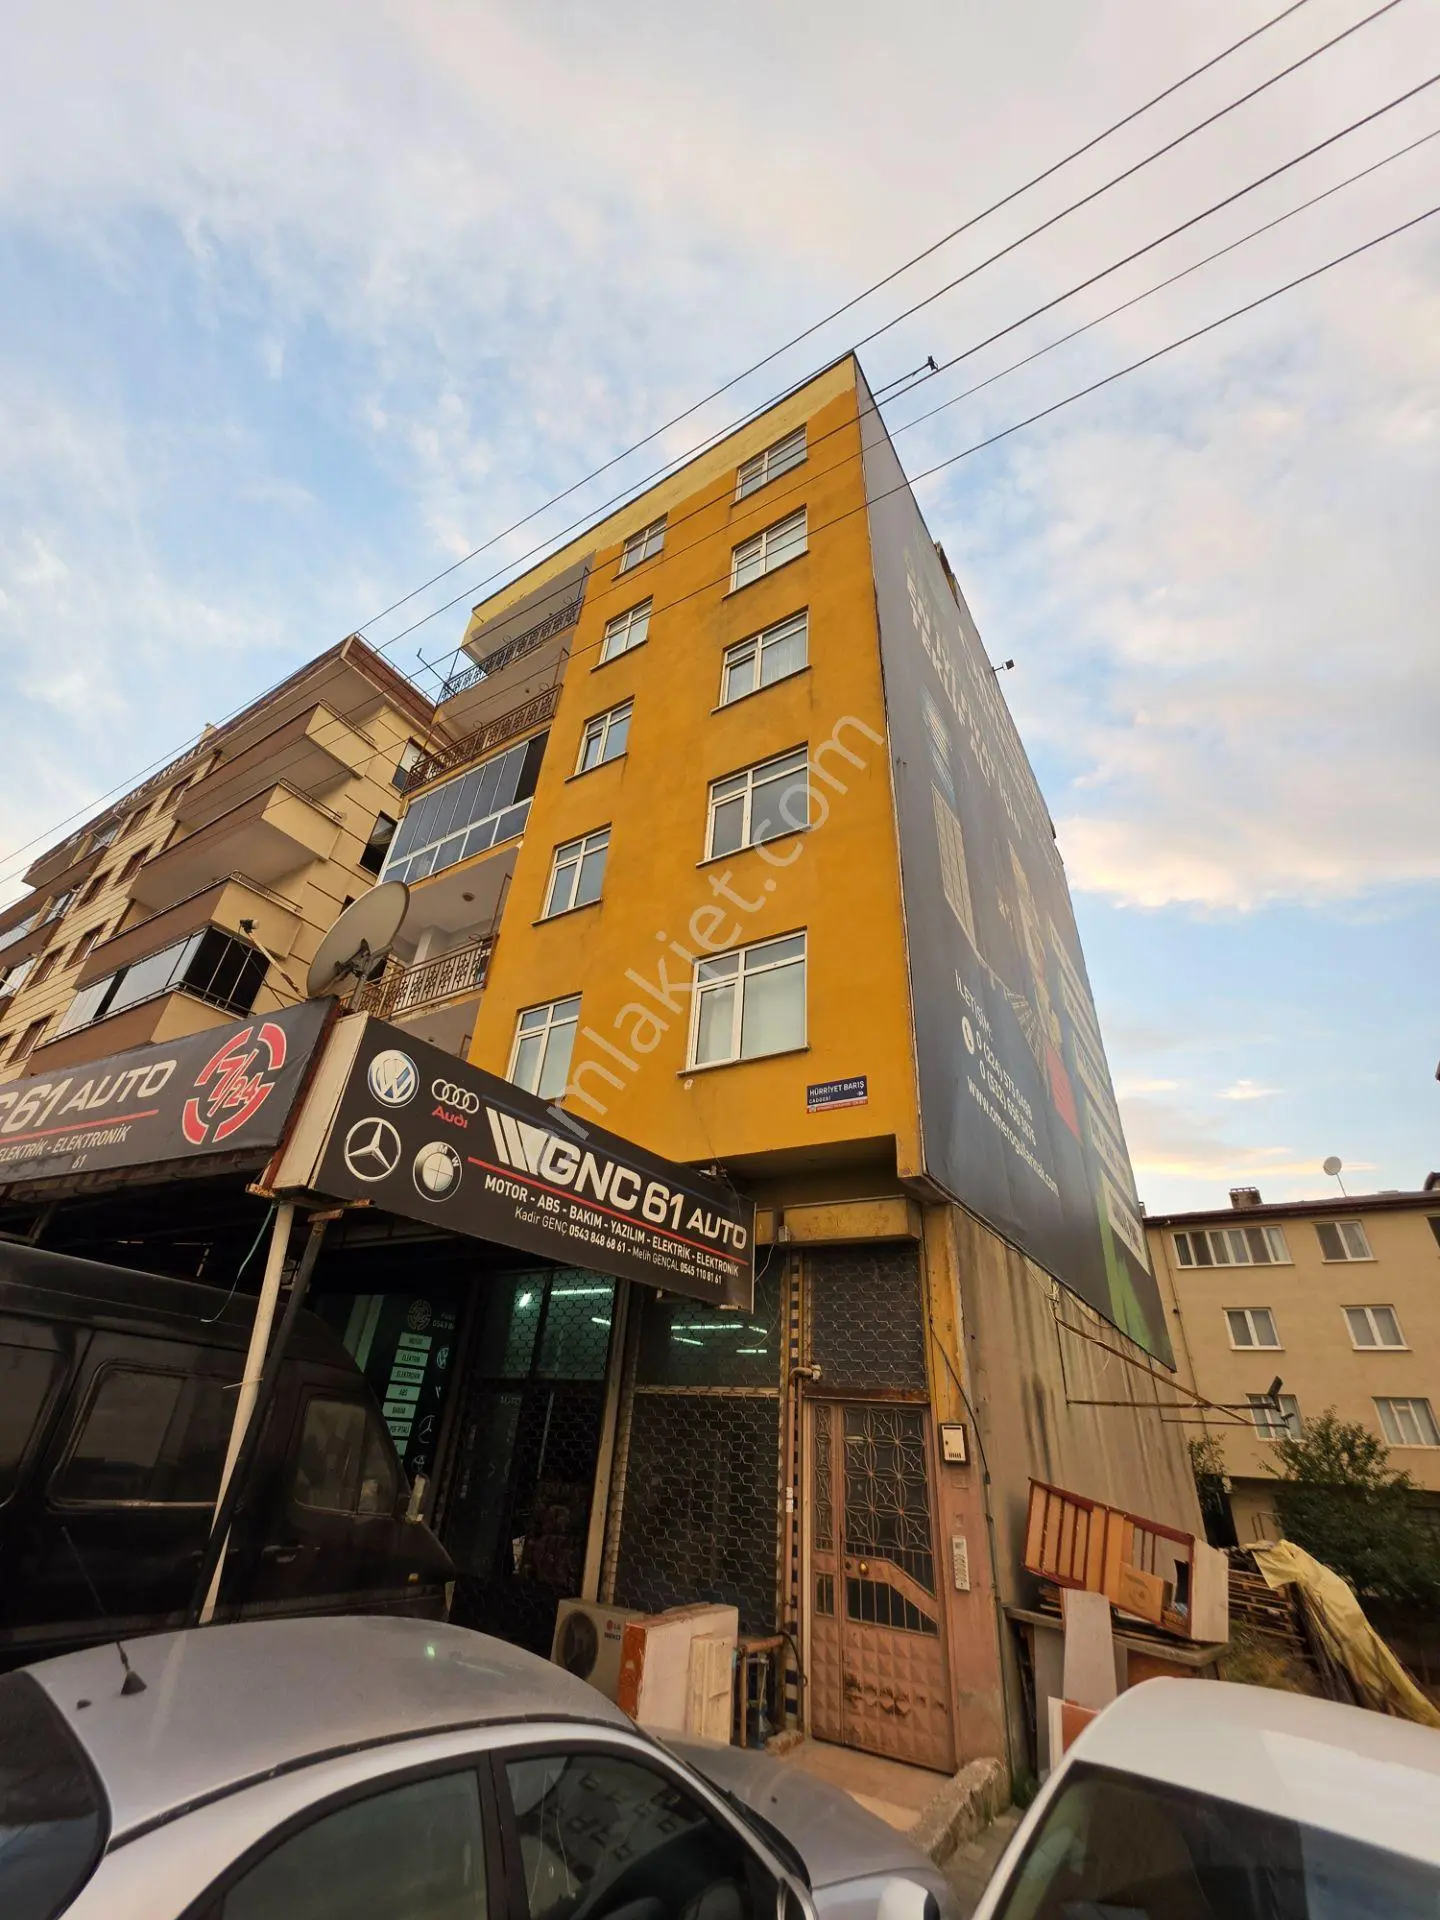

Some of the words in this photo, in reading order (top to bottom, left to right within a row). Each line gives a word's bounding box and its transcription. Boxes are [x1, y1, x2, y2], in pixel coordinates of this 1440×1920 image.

[57, 1059, 177, 1115] AUTO
[207, 1049, 264, 1118] 7/24
[810, 1084, 842, 1096] HÜRRİYET
[844, 1080, 865, 1091] BARIŞ
[432, 1106, 467, 1128] Audi
[52, 1124, 132, 1153] ELEKTRONİK
[72, 1155, 87, 1168] 61
[484, 1174, 528, 1203] MOTOR
[537, 1194, 560, 1213] ABS
[569, 1205, 602, 1229] BAKIM
[610, 1220, 645, 1244] YAZILIM
[652, 1235, 691, 1260] ELEKTRİK
[696, 1252, 739, 1278] ELEKTRONİK
[514, 1206, 540, 1225] Kadir
[542, 1215, 568, 1236] GENÇ
[569, 1224, 589, 1241] 0543
[590, 1232, 605, 1246] 848
[606, 1238, 615, 1250] 68
[617, 1241, 626, 1253] 61
[632, 1247, 651, 1263] Melih
[652, 1253, 679, 1271] GENÇAL
[680, 1262, 695, 1277] 0545
[696, 1268, 706, 1280] 110
[715, 1274, 722, 1285] 61
[686, 1208, 747, 1250] AUTO
